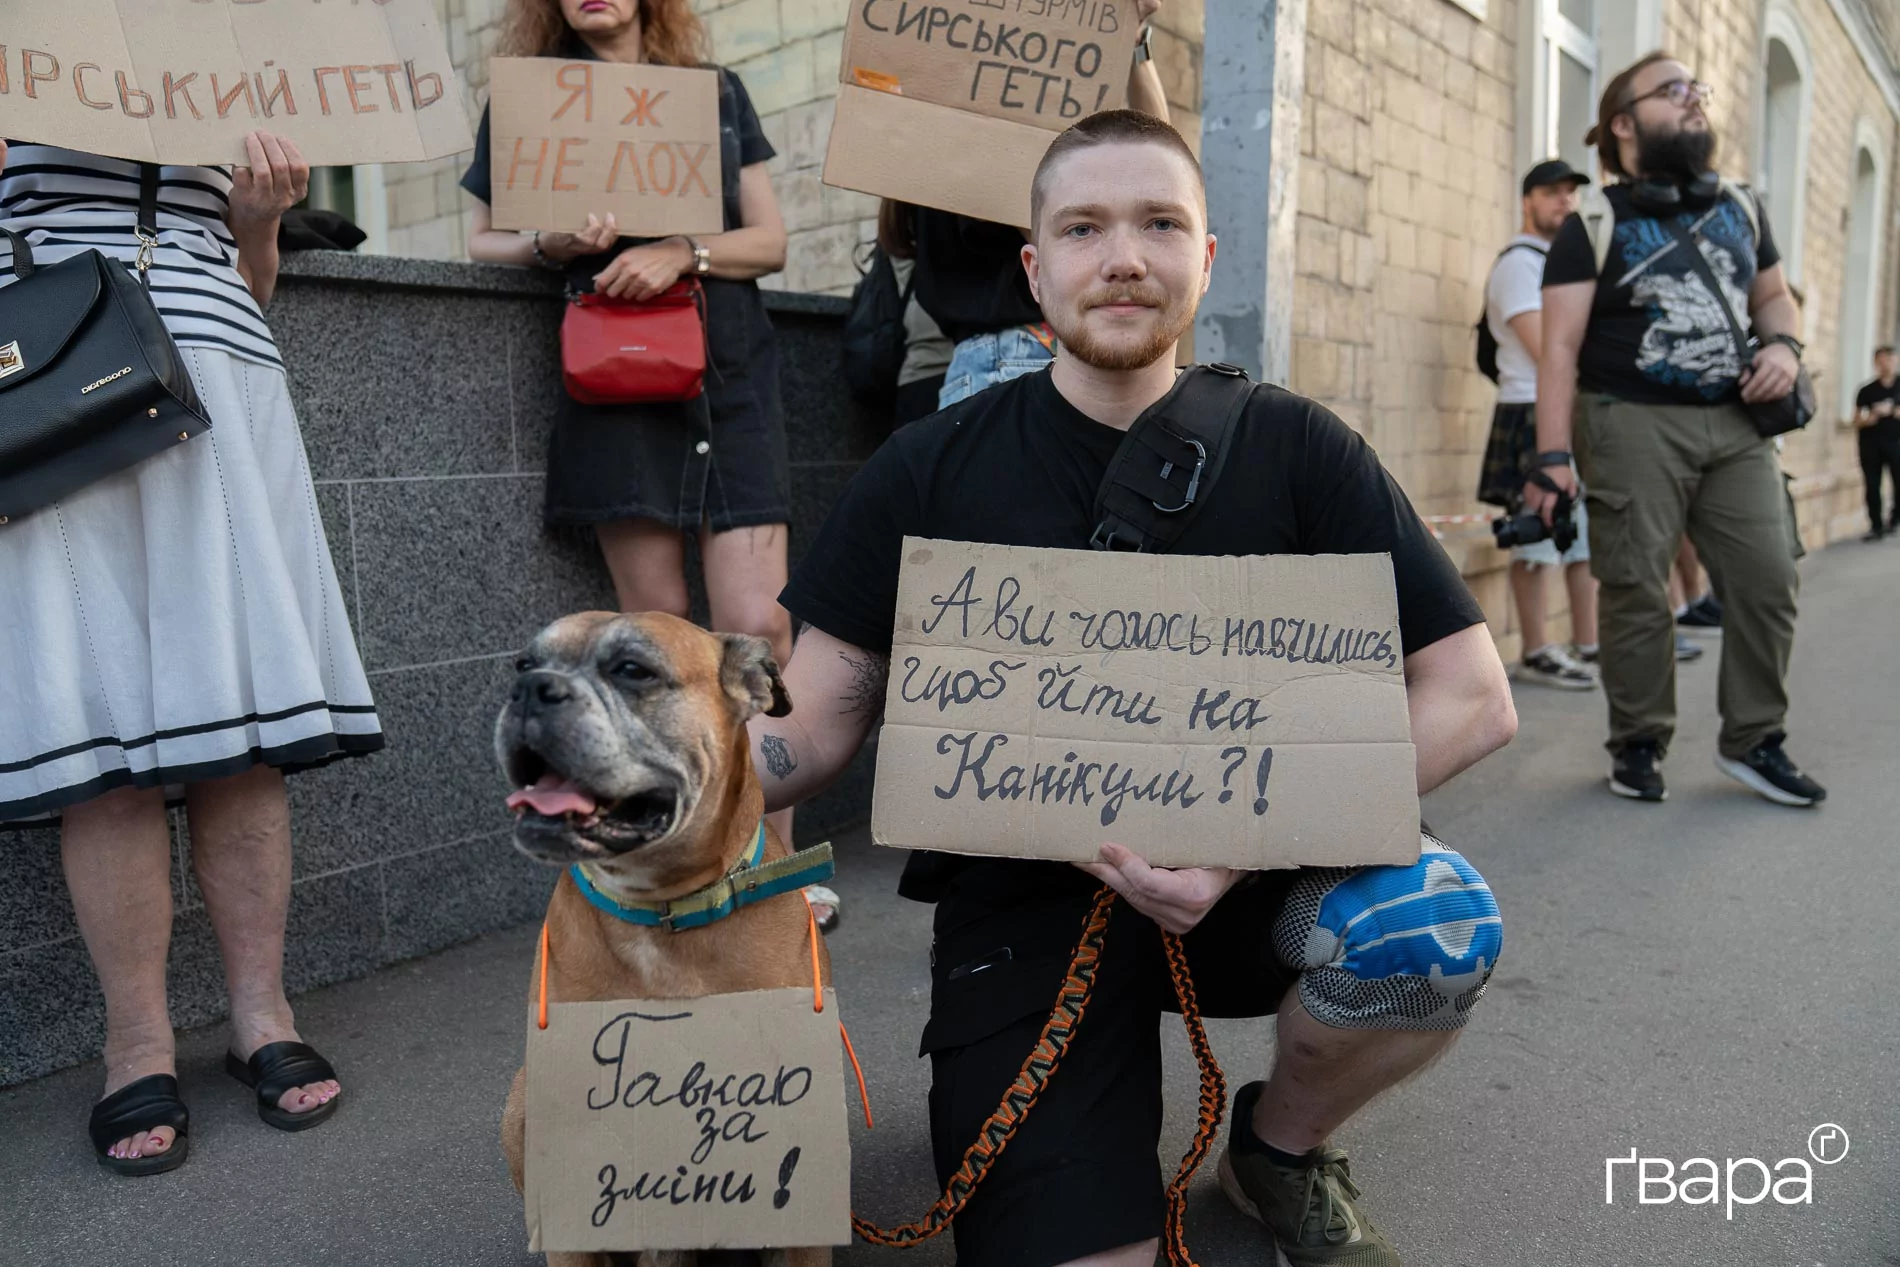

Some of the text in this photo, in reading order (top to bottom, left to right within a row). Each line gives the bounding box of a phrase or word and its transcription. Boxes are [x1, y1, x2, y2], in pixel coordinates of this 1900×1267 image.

[862, 0, 1103, 78] СИРСЬКОГО
[314, 58, 444, 116] ГЕТЬ
[551, 63, 593, 122] Я
[970, 60, 1110, 119] ГЕТЬ!
[507, 137, 712, 198] НЕ ЛОХ
[921, 565, 982, 638] А
[981, 576, 1055, 647] ви
[1069, 608, 1212, 656] чогось
[1037, 660, 1162, 724] йти
[1189, 687, 1272, 731] на
[587, 1012, 812, 1110] Гавкаю
[691, 1106, 769, 1164] за
